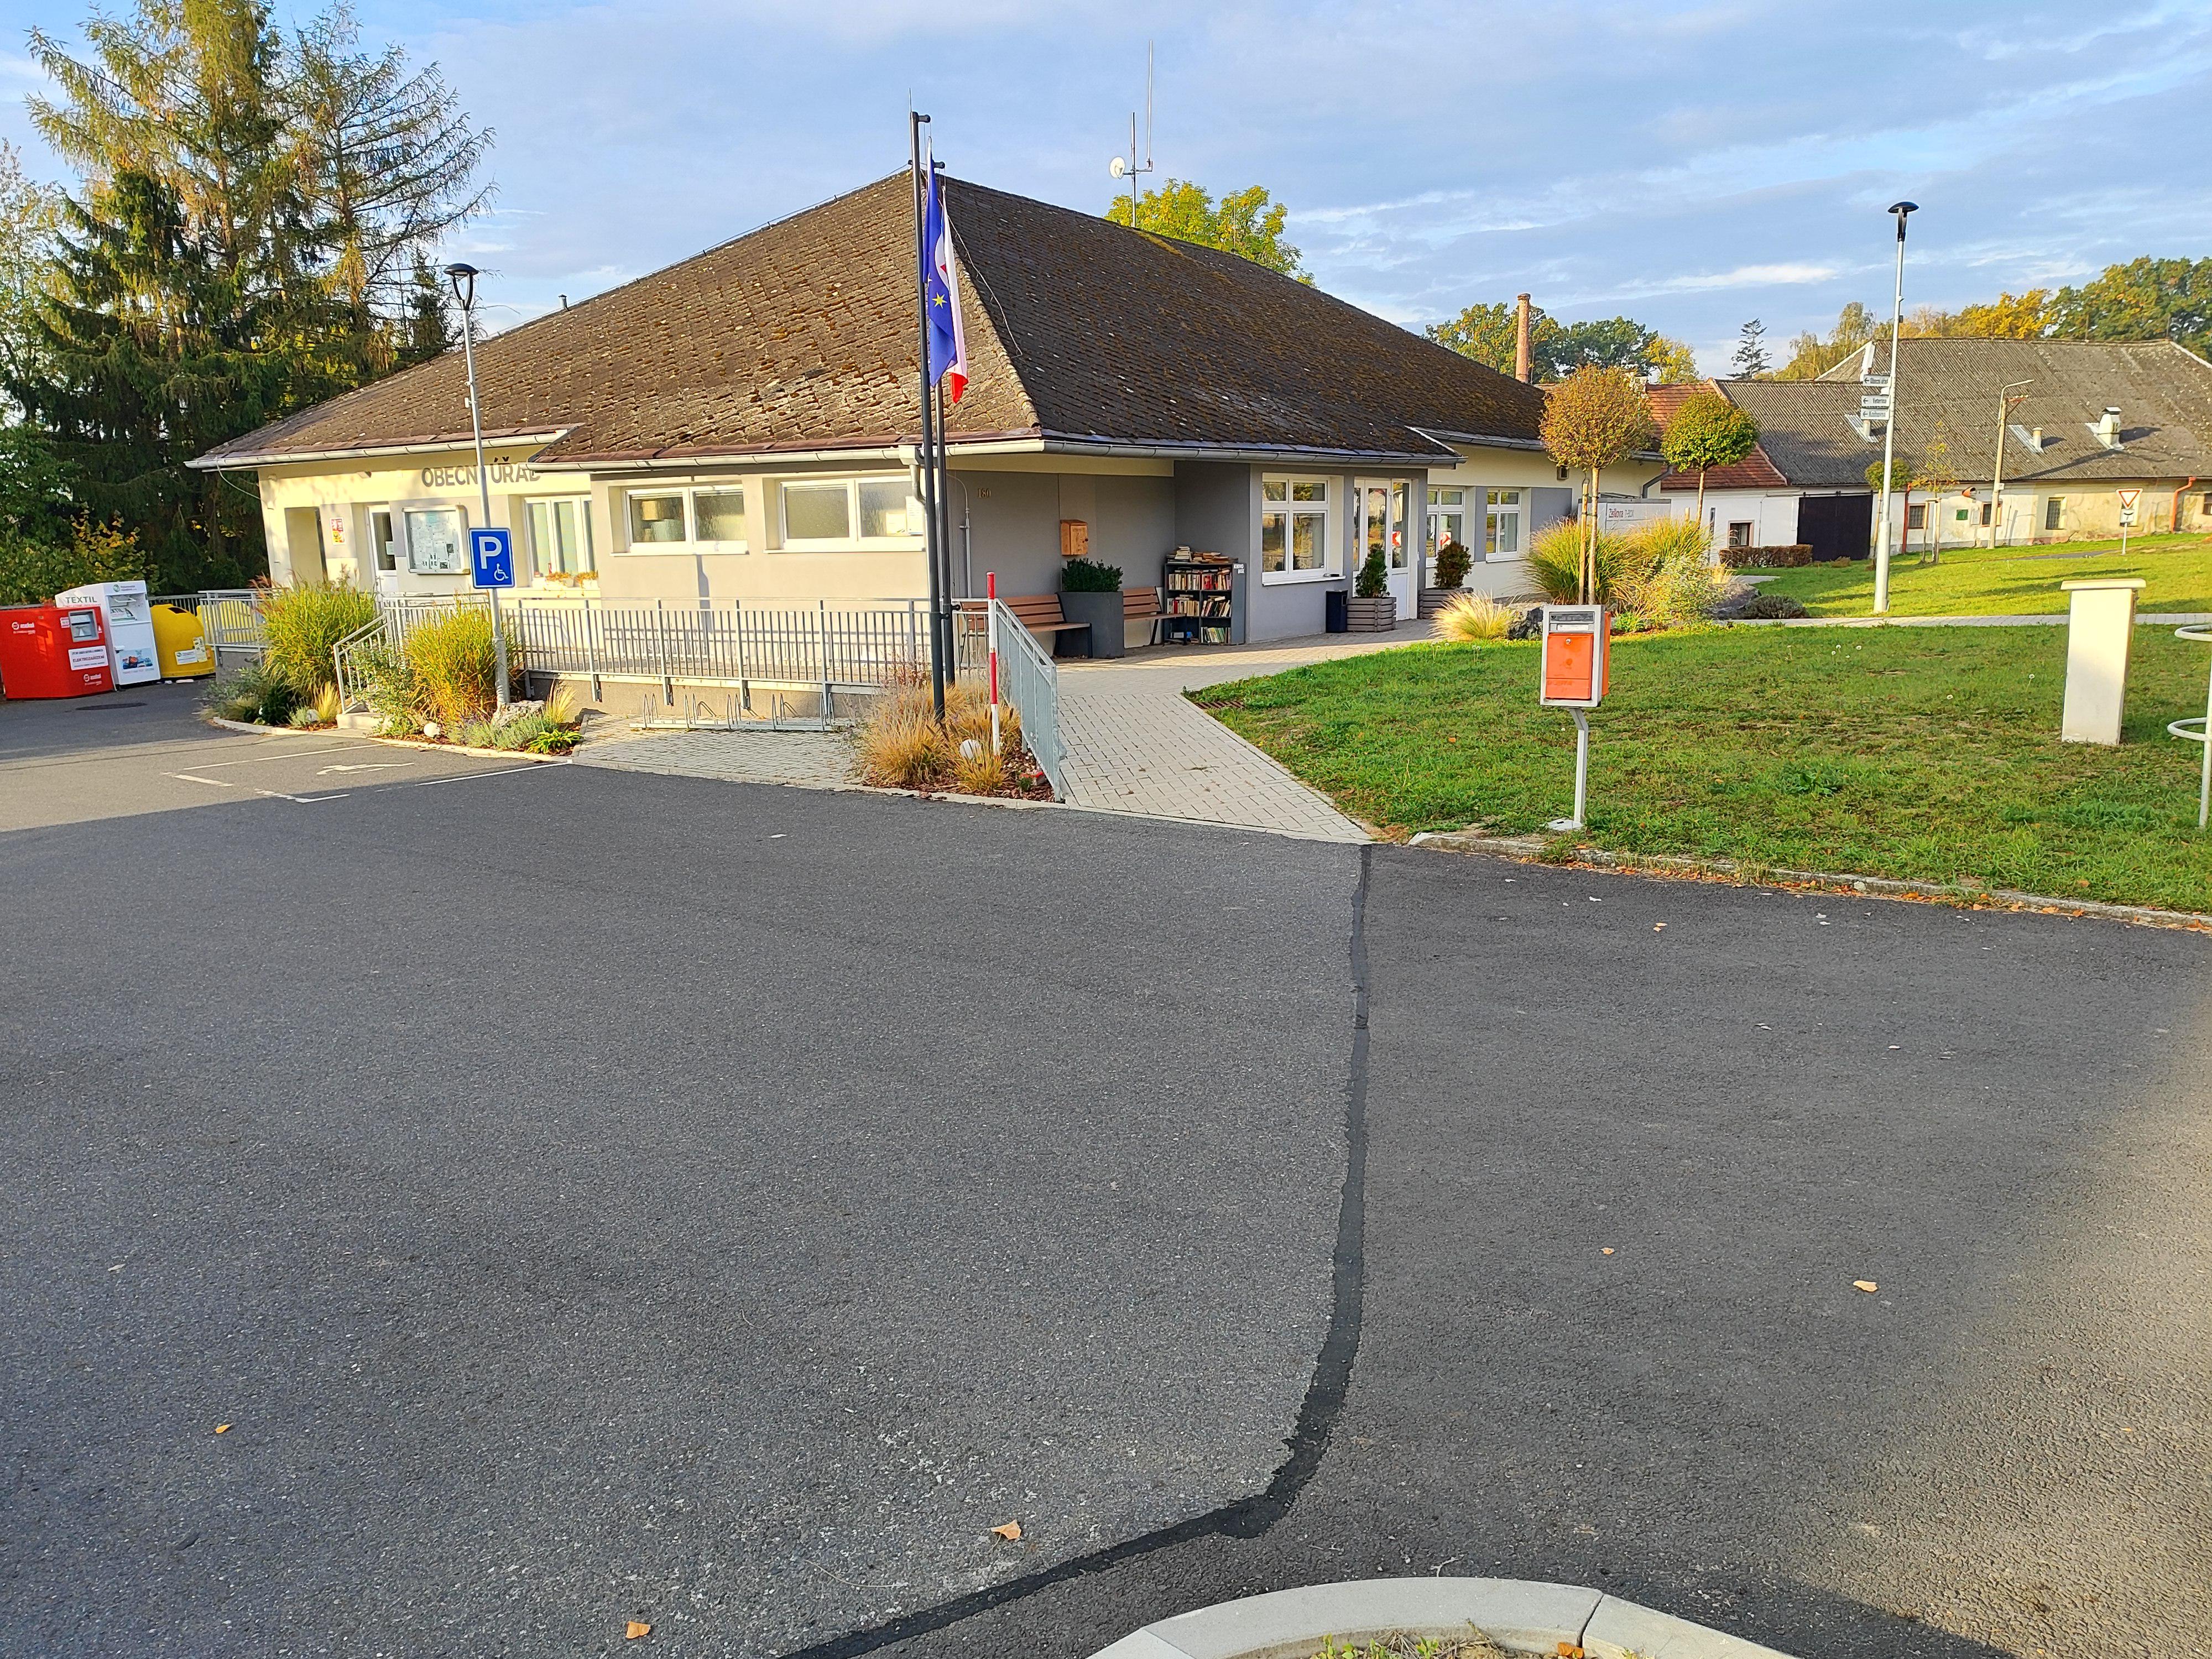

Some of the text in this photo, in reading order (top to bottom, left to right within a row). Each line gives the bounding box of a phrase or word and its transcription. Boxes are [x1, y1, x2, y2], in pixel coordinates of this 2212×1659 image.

[421, 465, 479, 487] OBECN
[978, 488, 991, 498] 180
[479, 536, 502, 570] P
